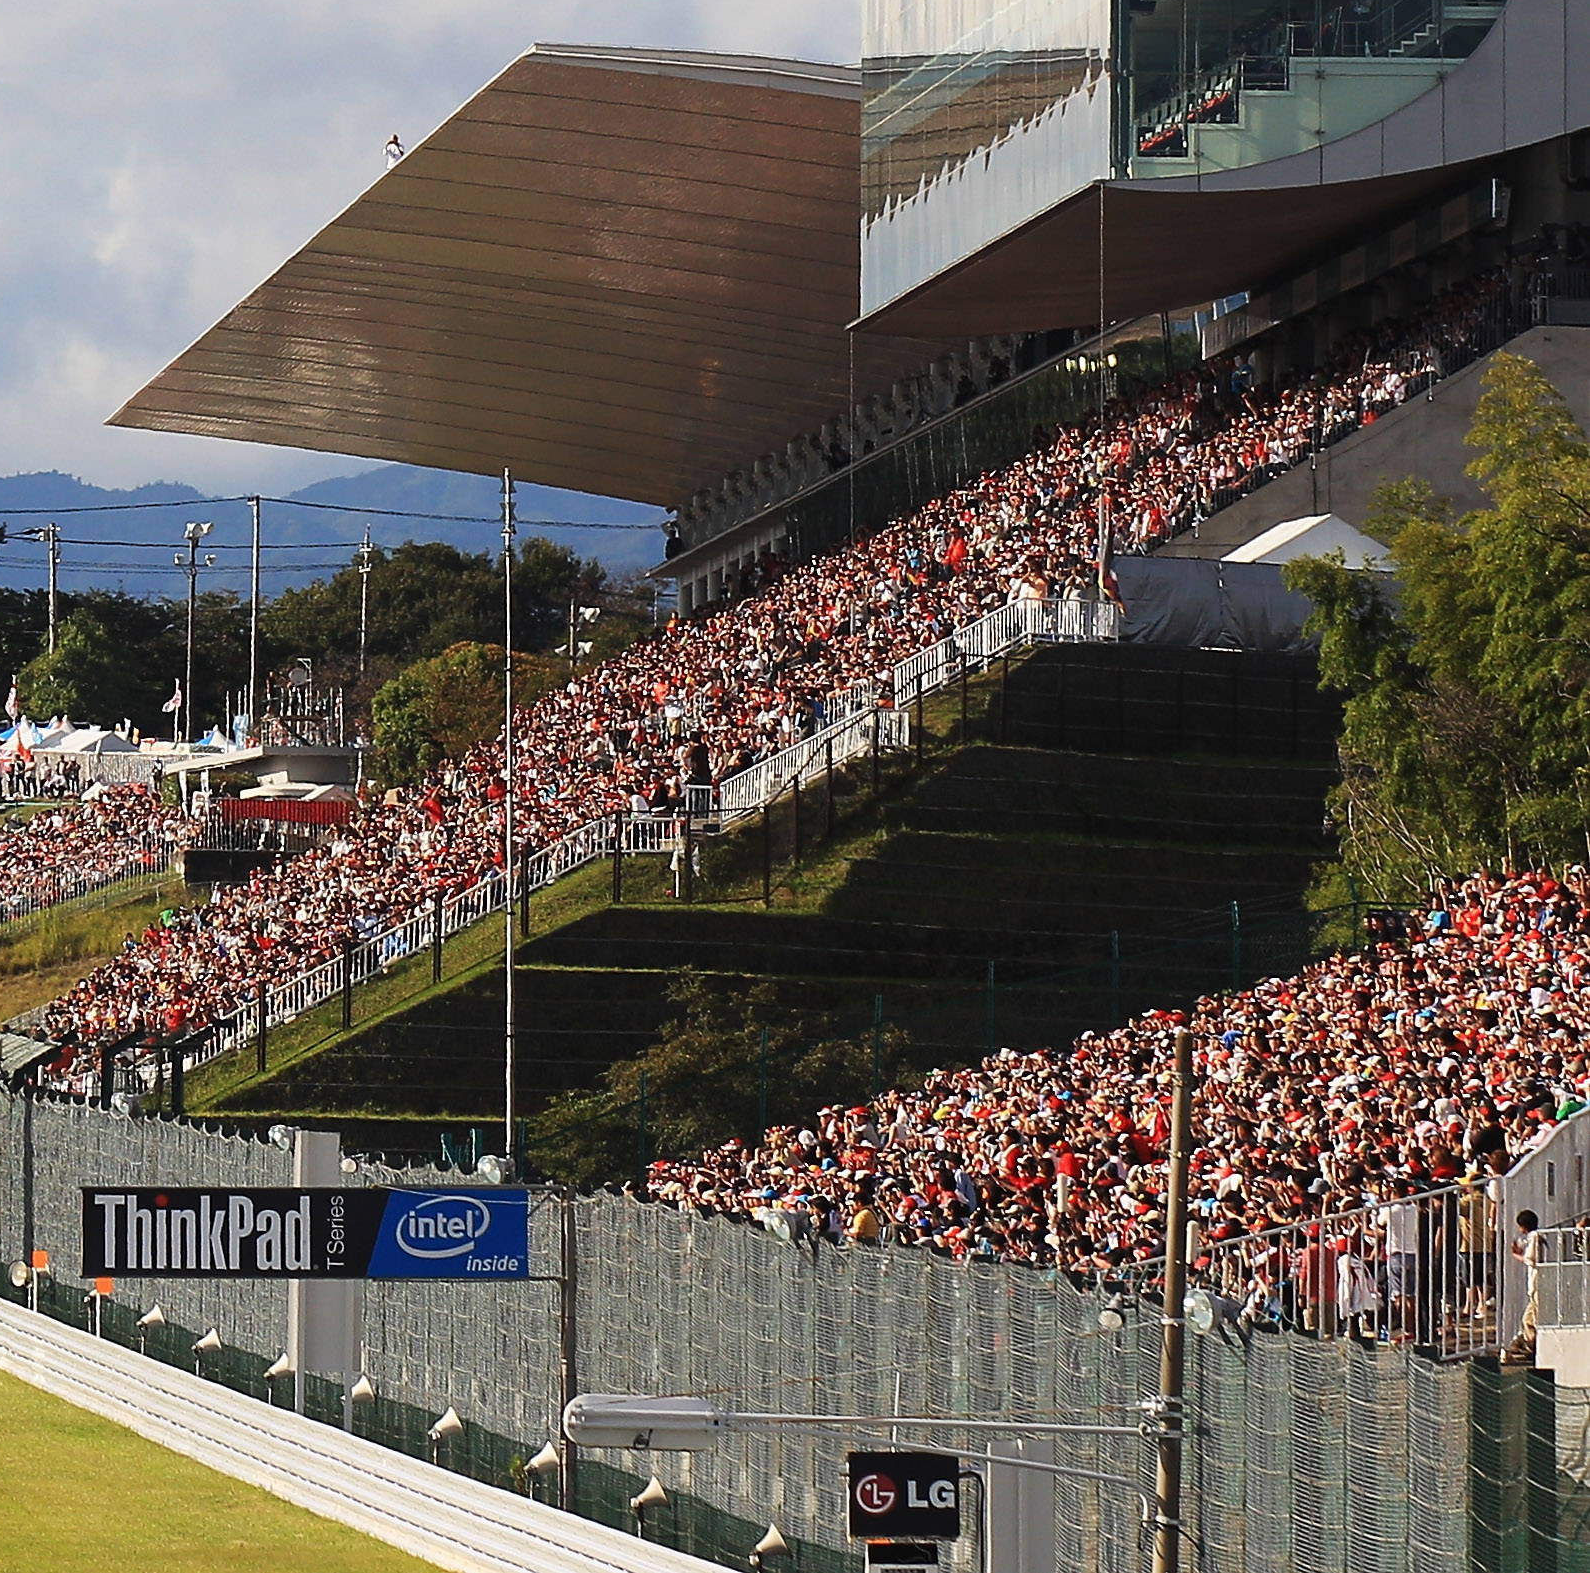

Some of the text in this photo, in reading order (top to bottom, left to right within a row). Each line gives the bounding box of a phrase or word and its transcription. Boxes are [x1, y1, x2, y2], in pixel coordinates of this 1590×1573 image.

[94, 1194, 310, 1270] ThinkPad
[326, 1195, 345, 1270] T Series
[407, 1209, 474, 1241] intel
[465, 1254, 519, 1272] inside
[907, 1480, 956, 1509] LG
